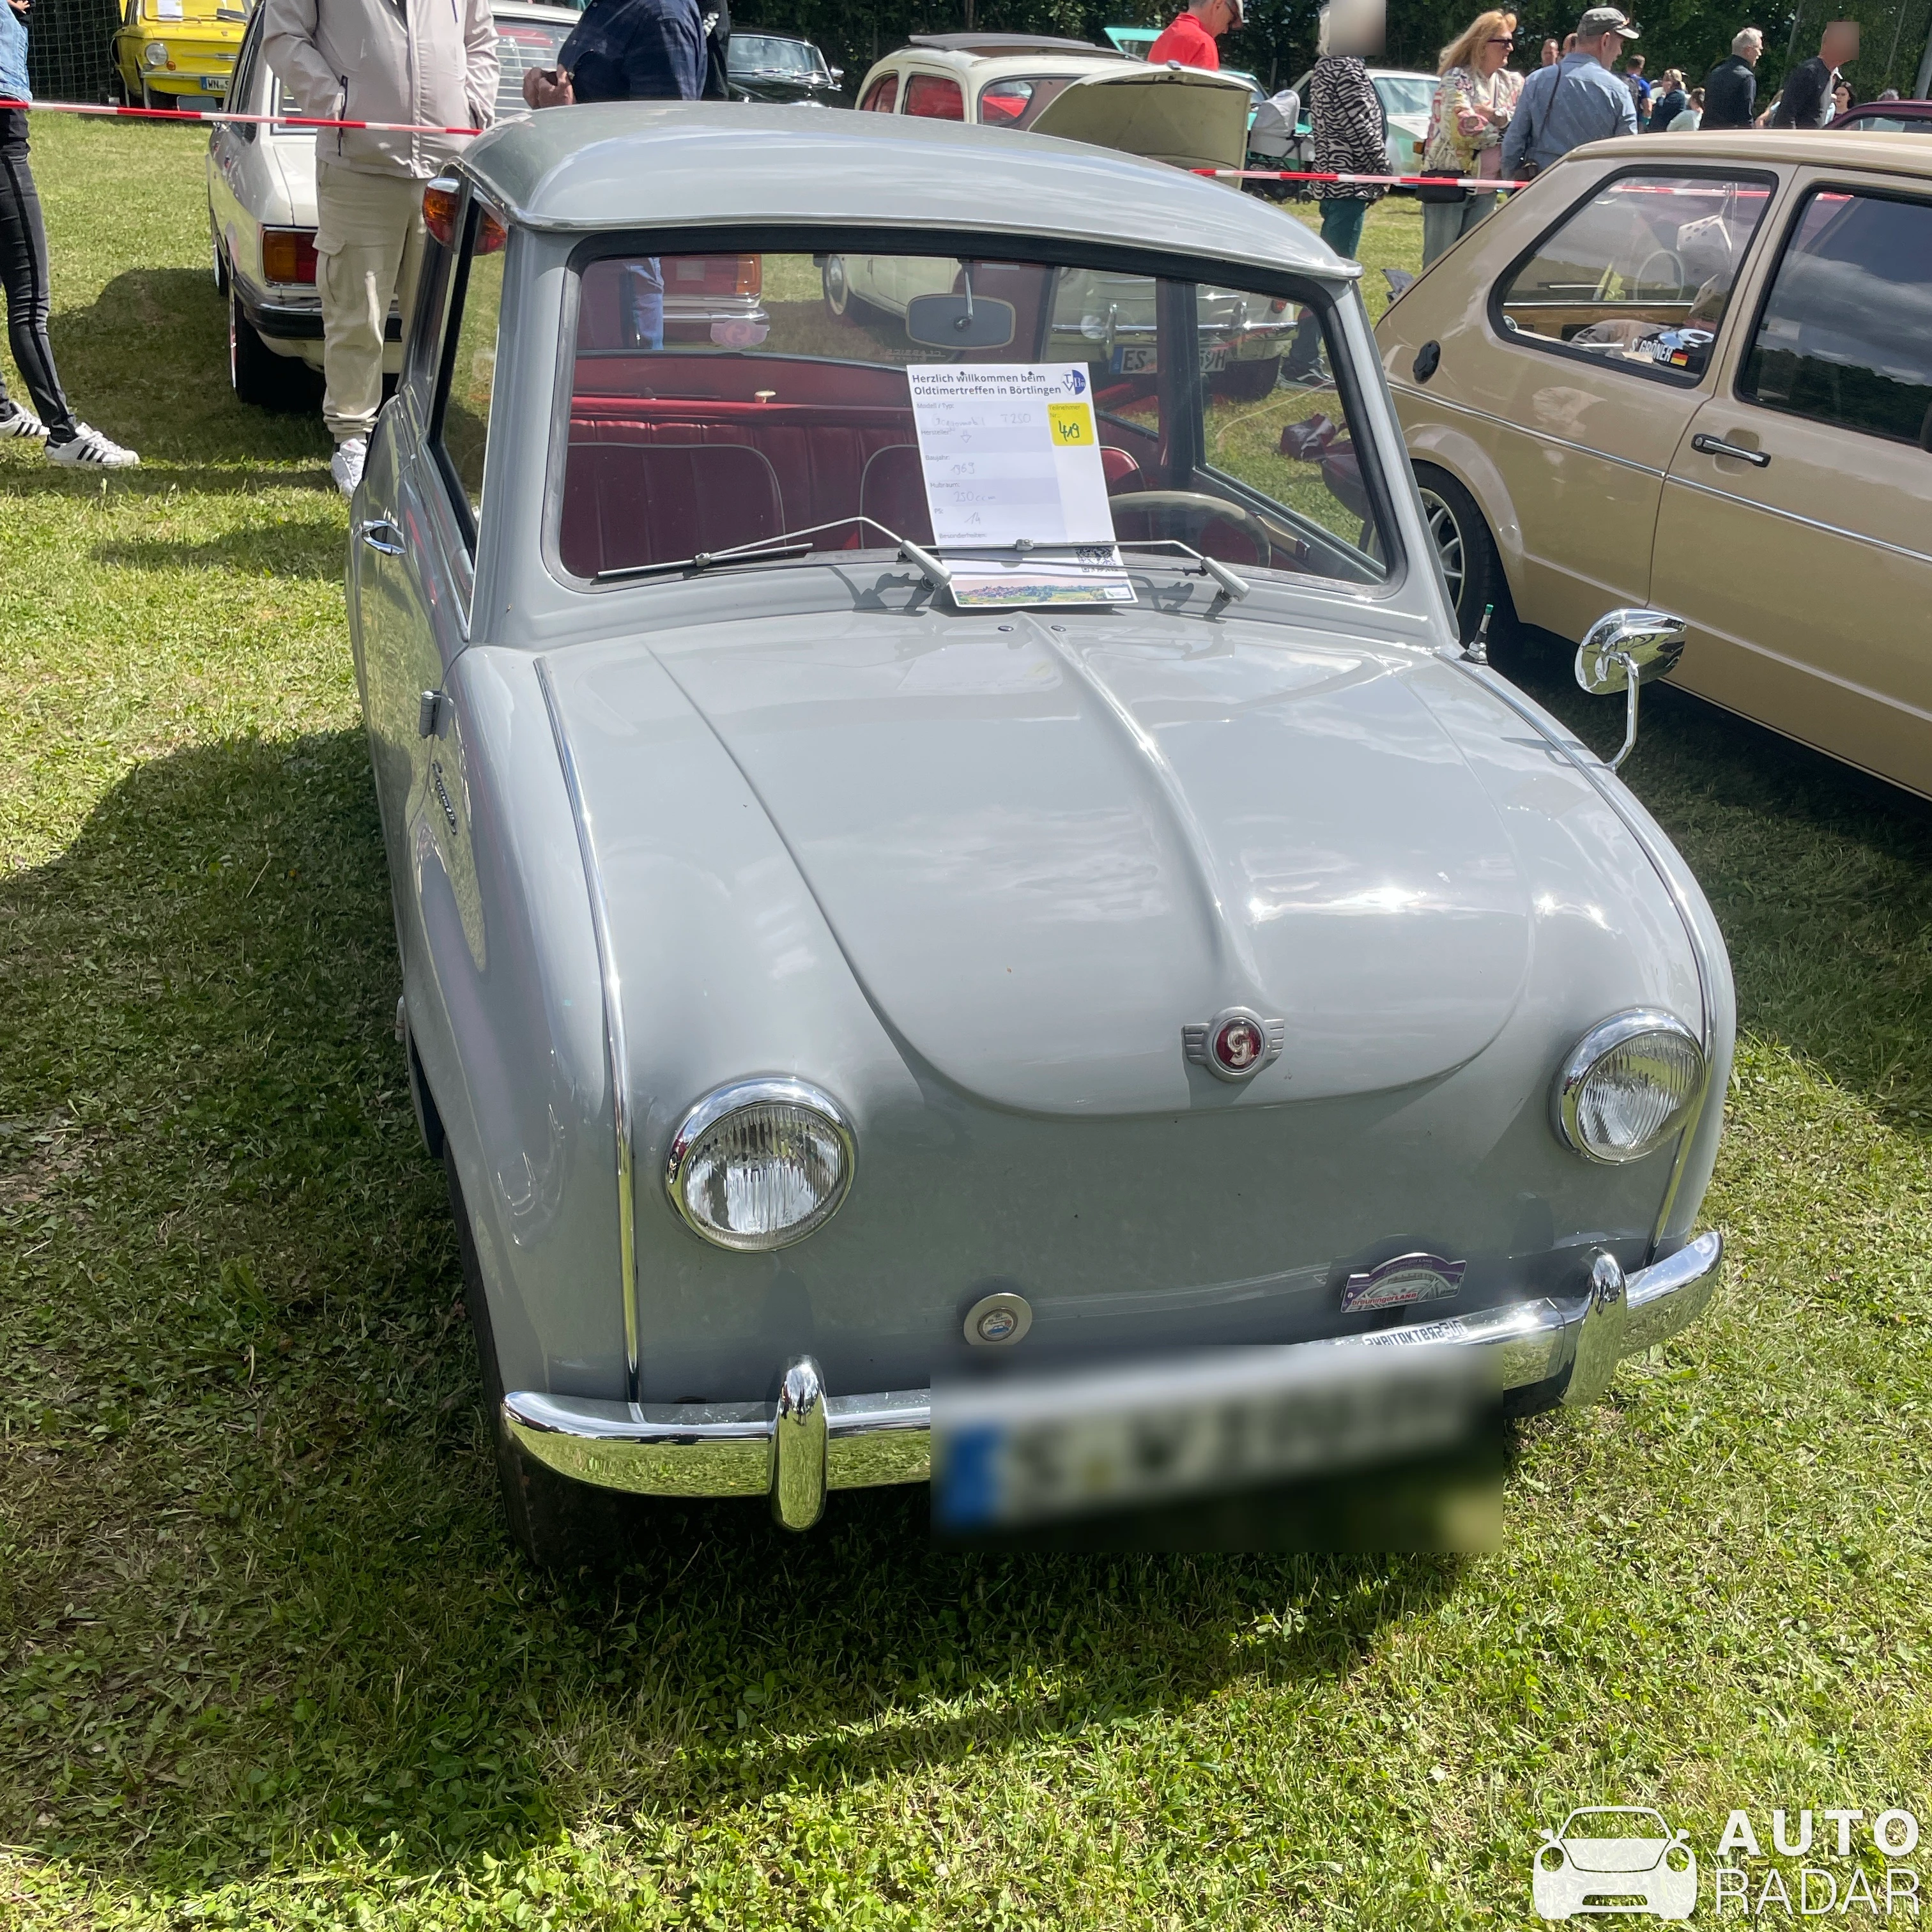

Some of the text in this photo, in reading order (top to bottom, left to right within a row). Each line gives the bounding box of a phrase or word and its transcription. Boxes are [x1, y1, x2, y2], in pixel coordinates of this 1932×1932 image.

[1124, 350, 1147, 371] ES
[912, 374, 1045, 383] Herzlich willkommen beim
[914, 386, 1061, 396] Oldtimertreffen in Börtlingen
